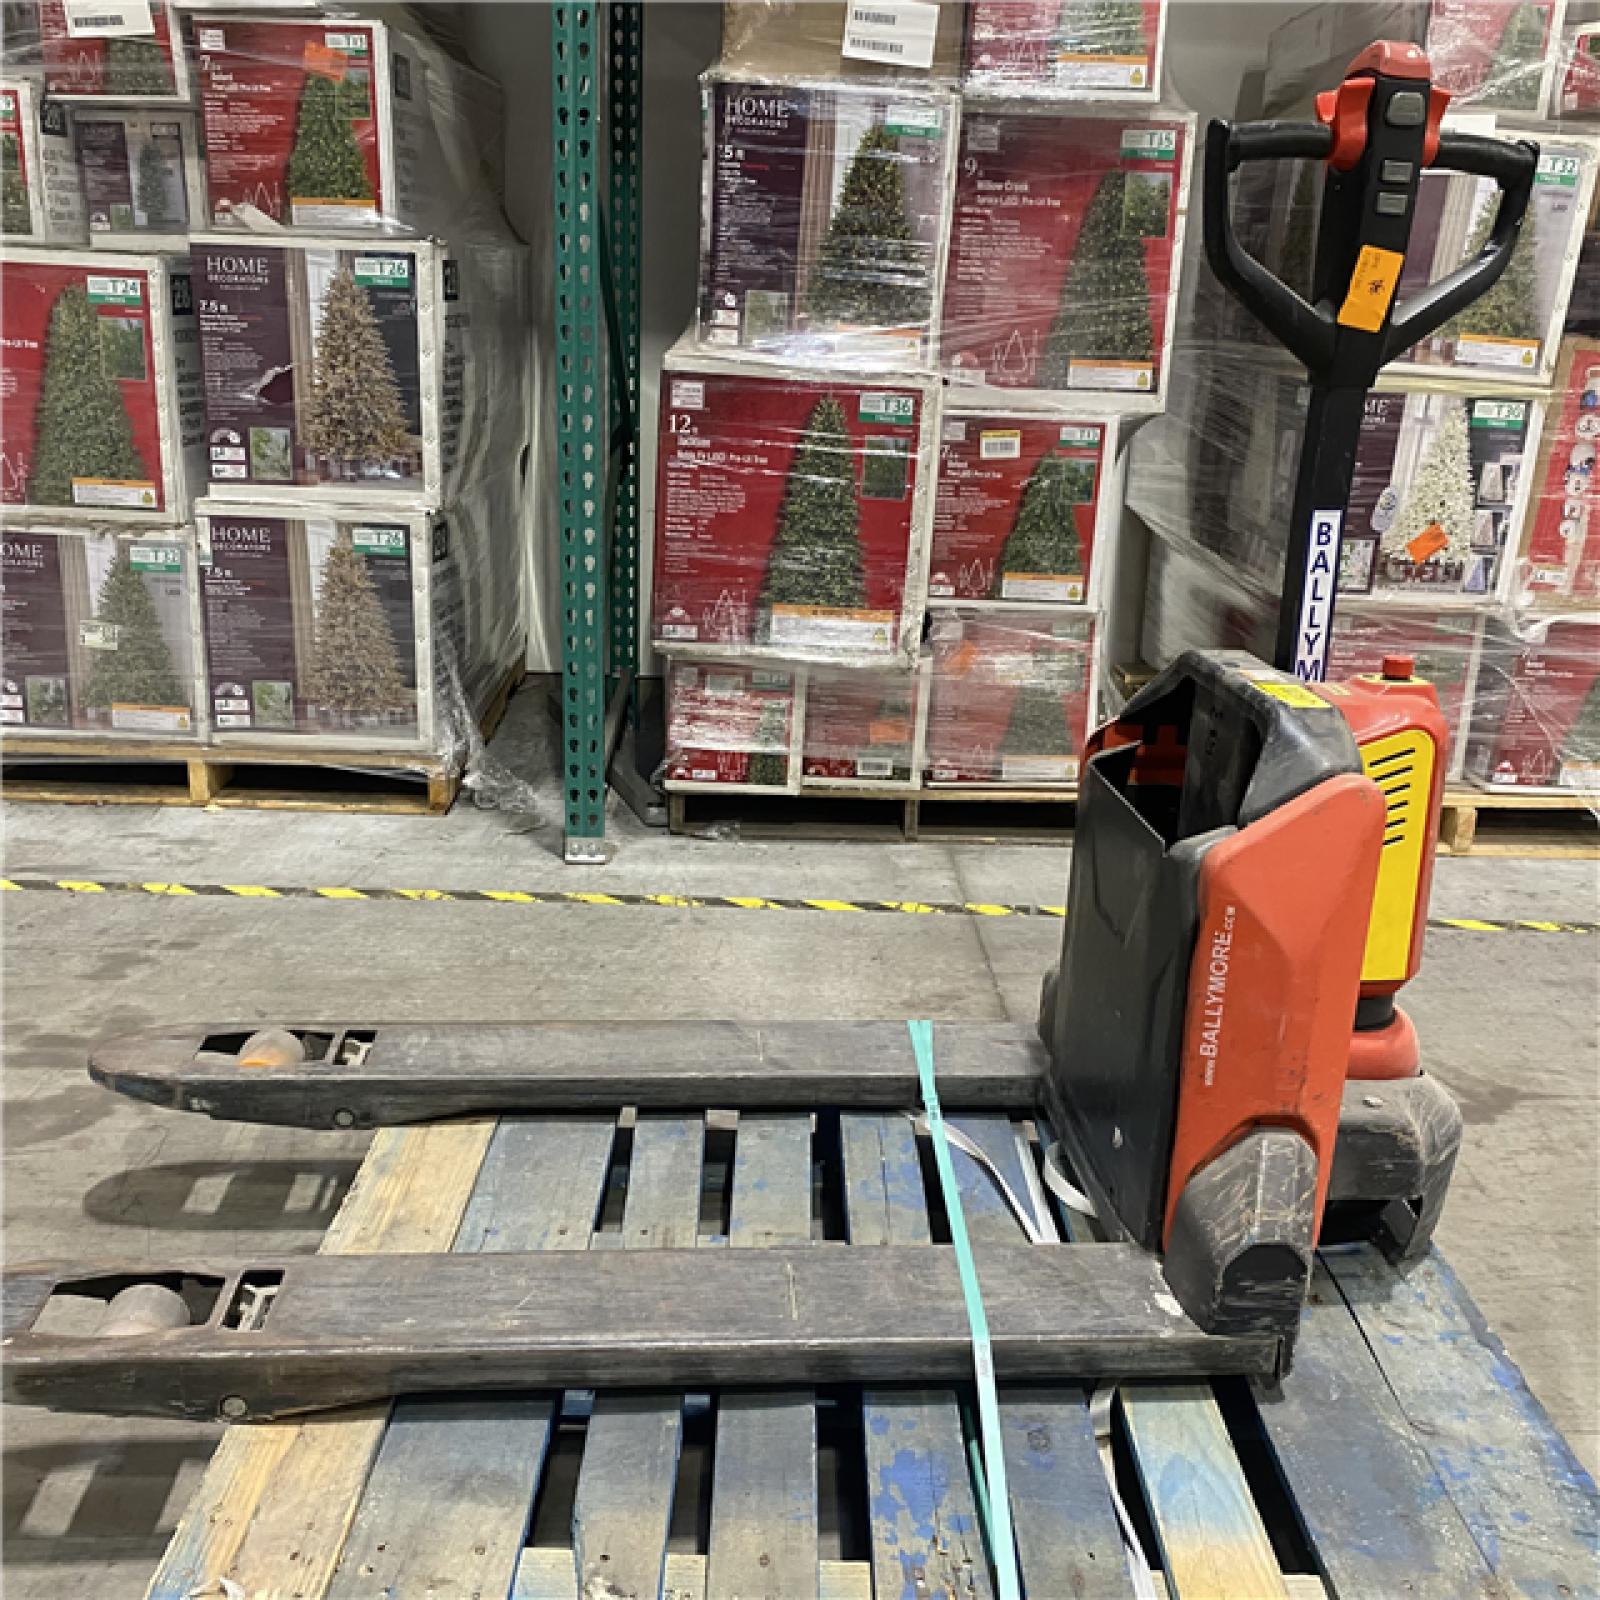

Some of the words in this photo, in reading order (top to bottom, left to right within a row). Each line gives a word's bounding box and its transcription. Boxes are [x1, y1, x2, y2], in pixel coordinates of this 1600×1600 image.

[724, 95, 789, 118] HOME
[206, 256, 270, 275] HOME
[669, 414, 692, 434] 12
[211, 526, 272, 544] HOME
